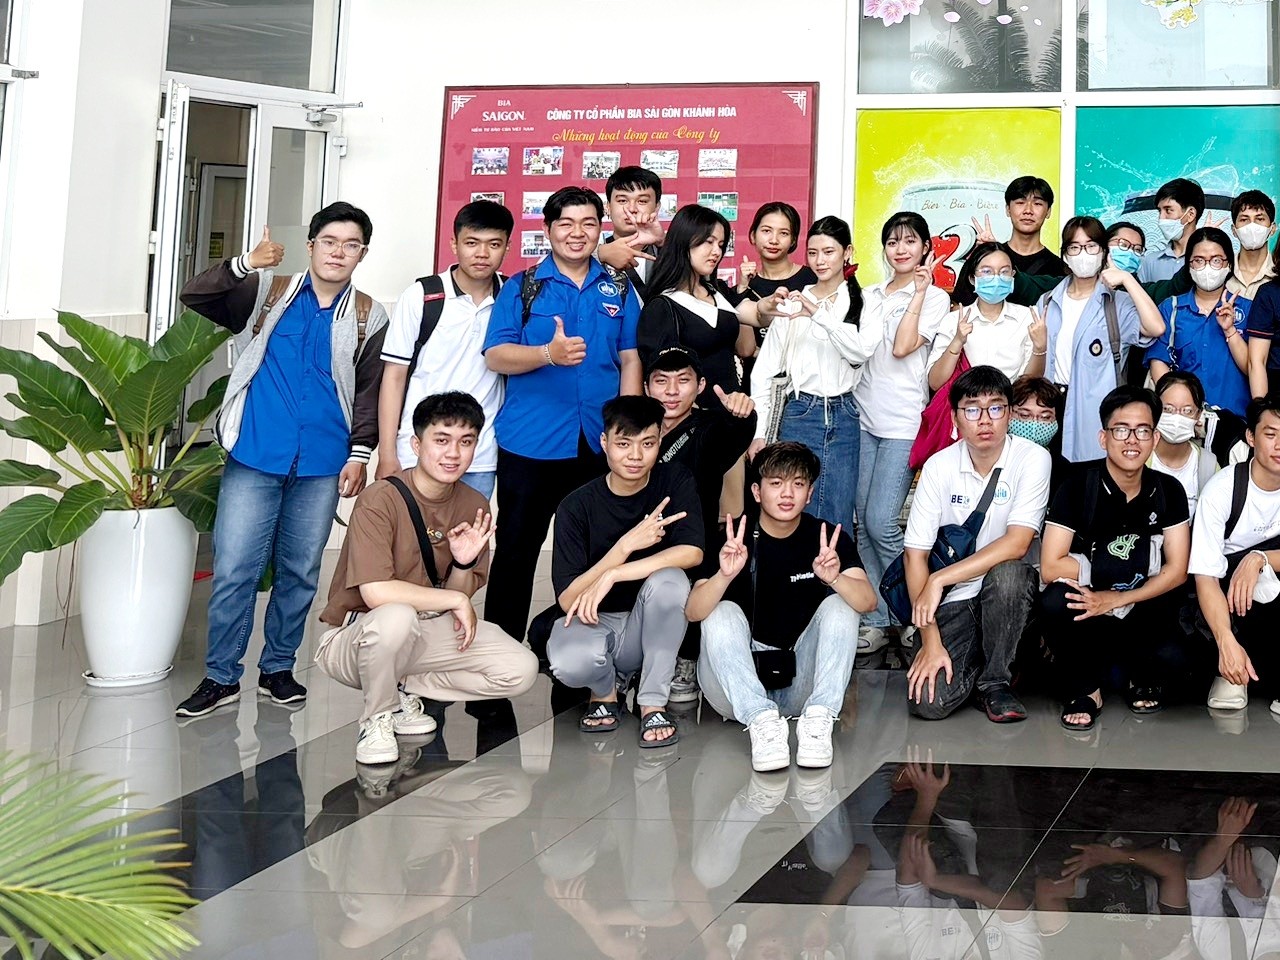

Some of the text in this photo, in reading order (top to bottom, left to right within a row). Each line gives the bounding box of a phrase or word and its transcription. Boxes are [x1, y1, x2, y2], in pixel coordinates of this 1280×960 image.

[482, 111, 524, 122] SAIGON
[547, 104, 736, 121] CÔNG TY CỔ PHẦN BIA SÀI GÒN KHÁNH HÒA
[922, 200, 940, 210] Bier
[950, 198, 966, 210] Bia
